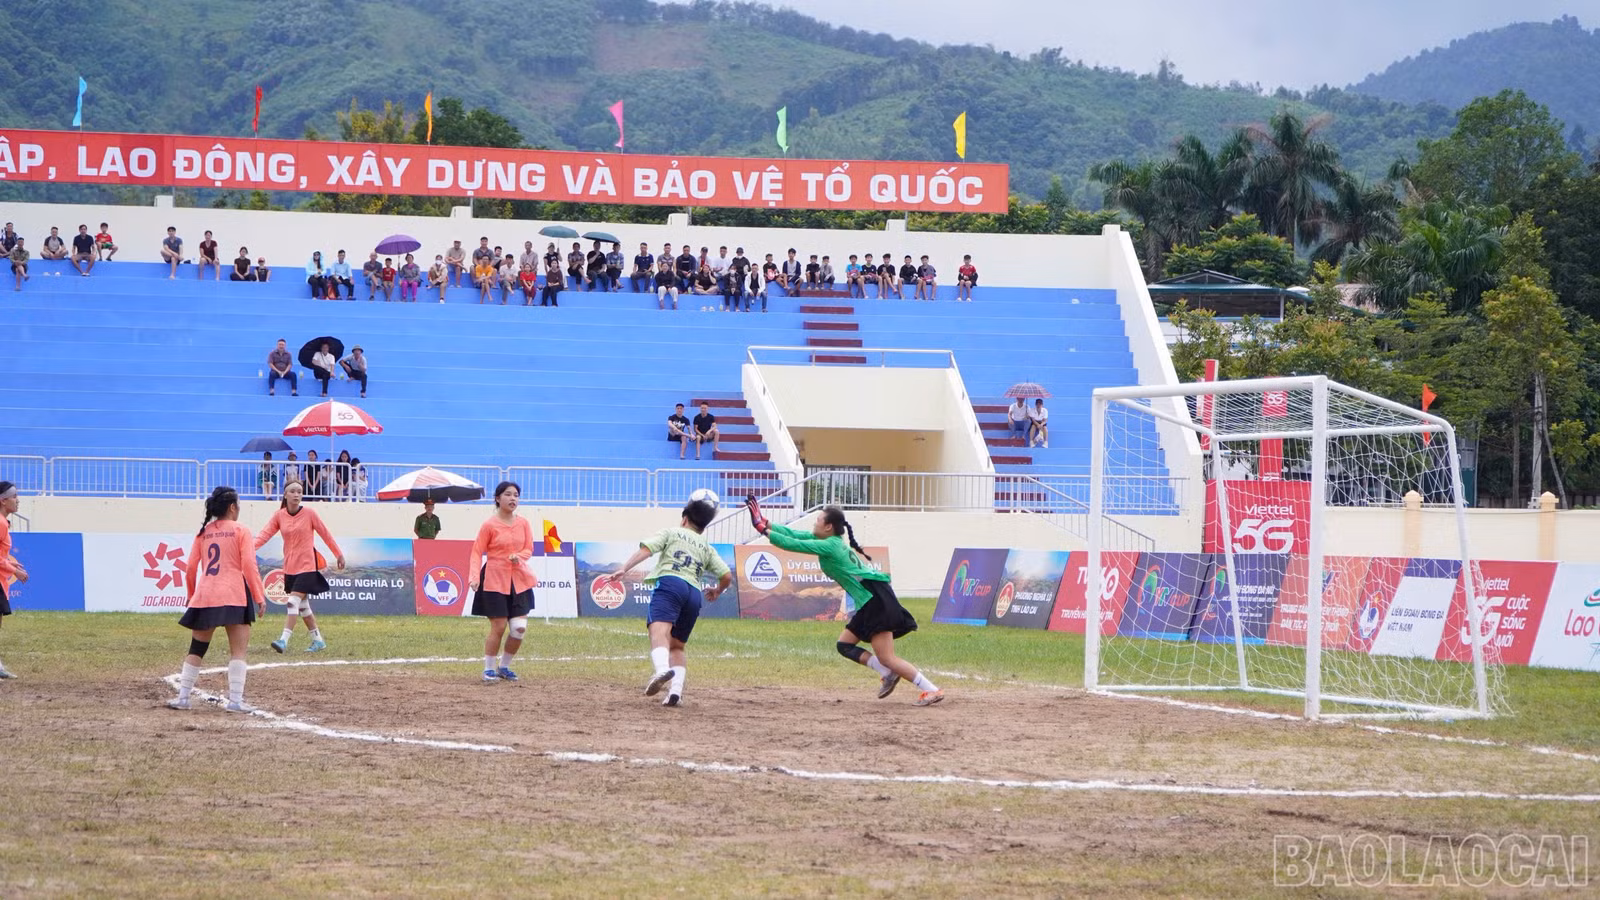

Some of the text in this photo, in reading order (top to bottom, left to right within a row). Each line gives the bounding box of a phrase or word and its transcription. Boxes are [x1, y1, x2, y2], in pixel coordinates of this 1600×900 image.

[77, 145, 157, 178] LAO
[172, 143, 308, 189] ĐỘNG,
[326, 150, 411, 188] XÂY
[427, 158, 546, 197] DỰNG
[562, 158, 617, 196] VÀ
[633, 160, 716, 200] BẢO
[732, 166, 784, 207] VỆ
[800, 162, 852, 202] TỔ
[869, 166, 983, 206] QUỐC
[338, 412, 353, 420] 5G
[1245, 504, 1295, 516] viettel
[1233, 518, 1295, 555] 5G
[205, 543, 221, 577] 2
[354, 577, 389, 588] NGHĨA
[391, 577, 405, 590] LỘ
[558, 579, 572, 589] ĐÁ
[335, 590, 356, 601] LÀO
[358, 592, 376, 601] CAI
[633, 594, 652, 604] TỈN
[1507, 594, 1531, 611] CUỘC
[1501, 611, 1526, 630] SỐNG
[1564, 609, 1596, 637] Lao
[1494, 631, 1515, 647] MỚI
